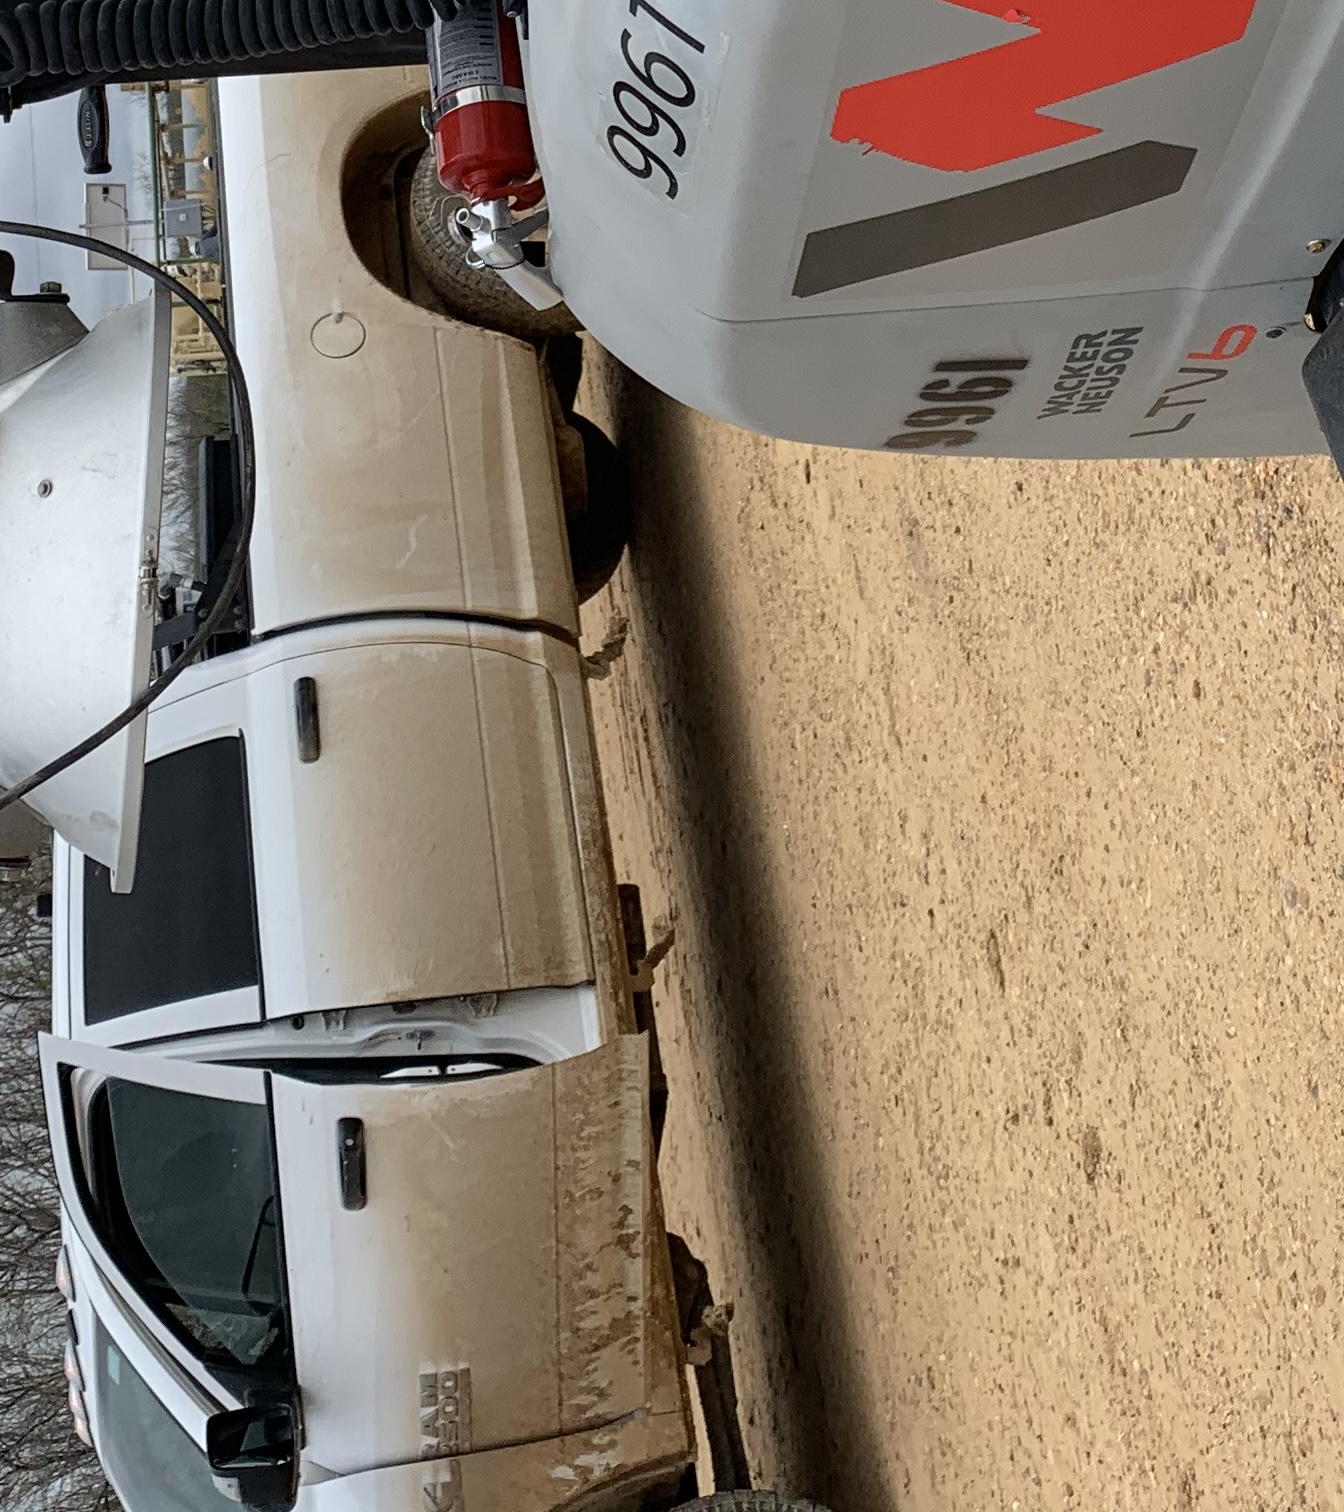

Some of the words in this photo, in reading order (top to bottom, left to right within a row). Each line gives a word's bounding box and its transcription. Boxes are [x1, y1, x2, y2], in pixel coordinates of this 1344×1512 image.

[883, 359, 1028, 449] 9961
[1036, 330, 1108, 420] WACKER
[1072, 326, 1144, 414] NEUSON
